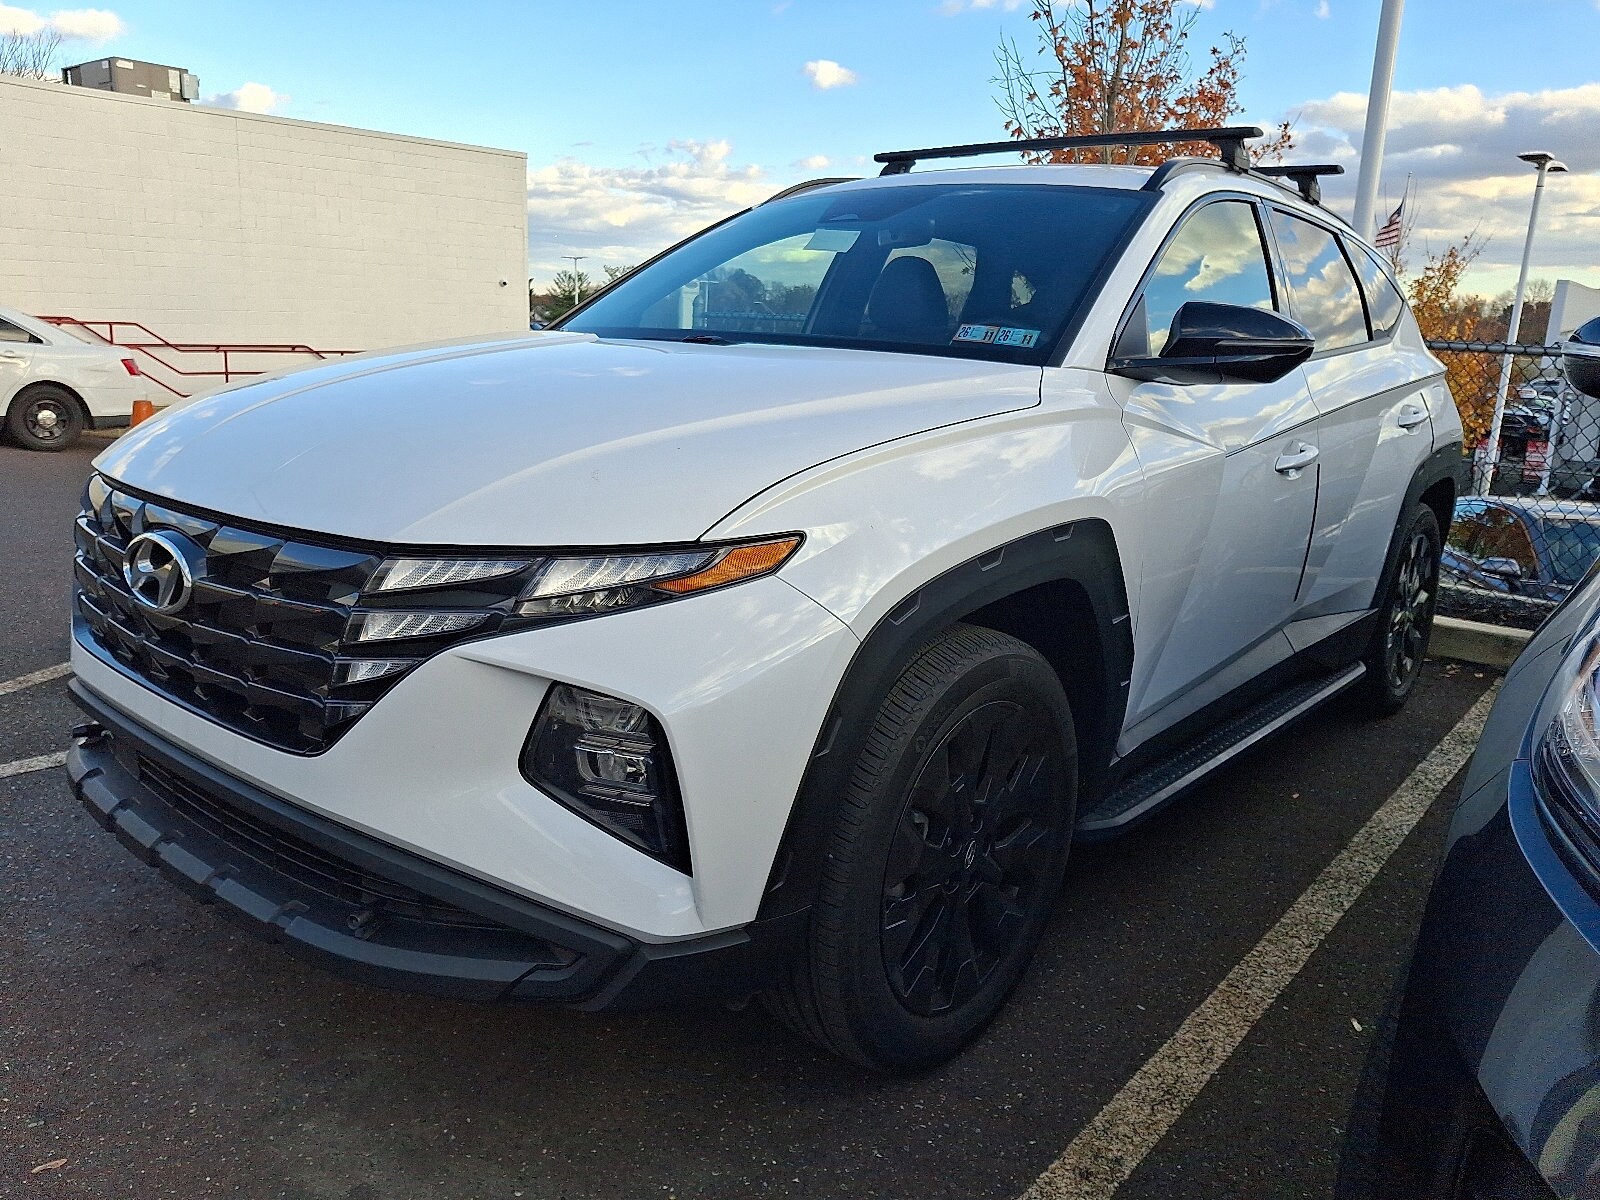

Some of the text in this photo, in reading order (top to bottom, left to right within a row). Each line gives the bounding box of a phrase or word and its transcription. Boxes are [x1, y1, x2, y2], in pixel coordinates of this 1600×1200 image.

[958, 326, 994, 341] 26 11
[998, 329, 1032, 344] 26 11
